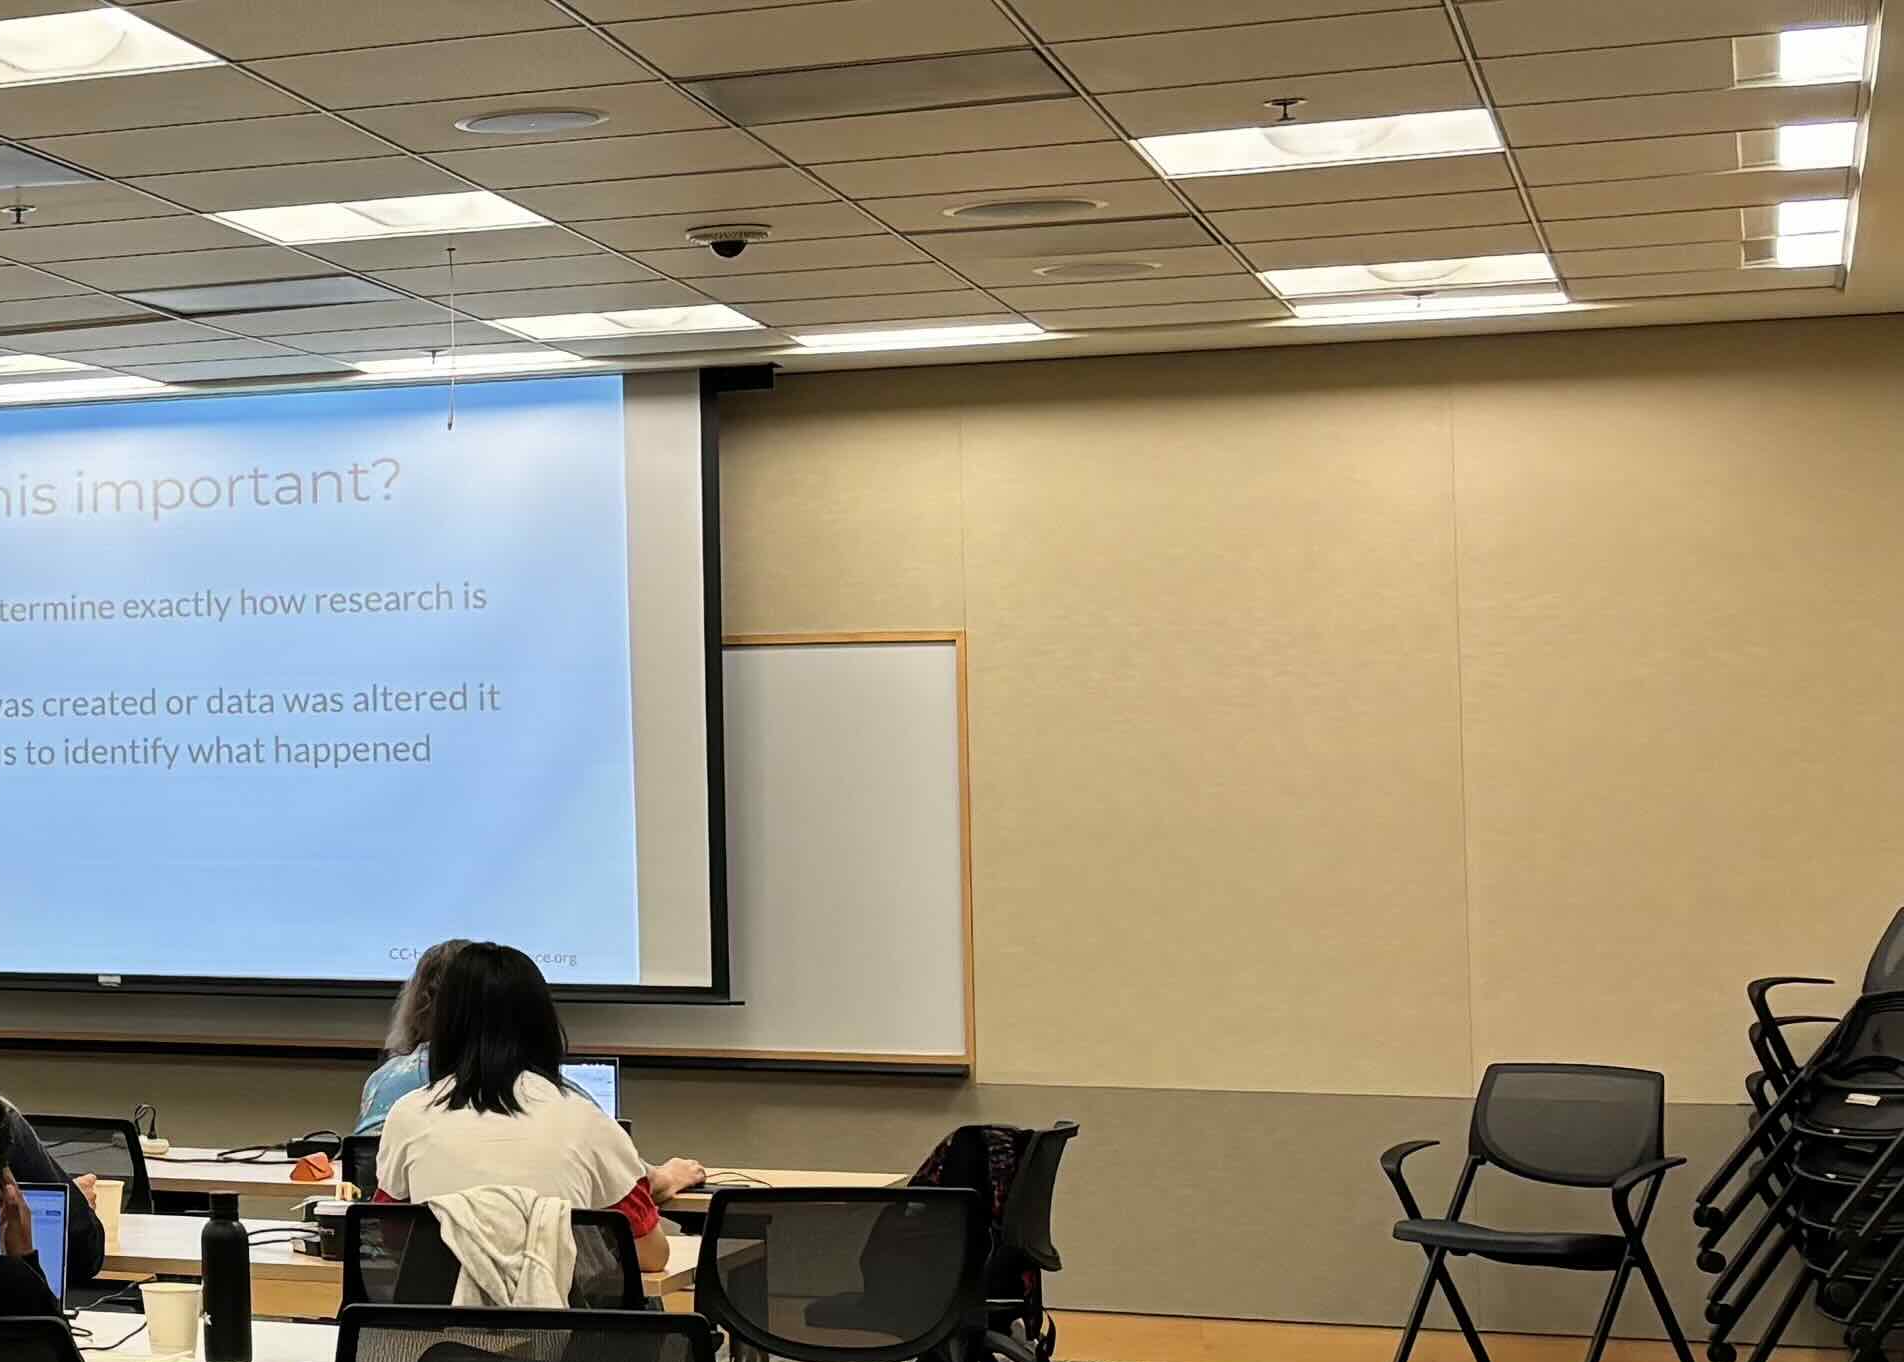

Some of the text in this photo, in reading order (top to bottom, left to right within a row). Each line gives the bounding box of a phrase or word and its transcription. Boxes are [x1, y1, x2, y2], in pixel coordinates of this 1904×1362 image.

[76, 457, 400, 520] important?
[122, 590, 232, 622] exactly
[240, 588, 306, 616] how
[314, 582, 454, 613] research
[463, 582, 488, 610] is
[41, 688, 156, 717] created
[166, 694, 198, 715] or
[206, 688, 275, 714] data
[283, 692, 345, 713] was
[353, 682, 468, 712] altered
[479, 682, 502, 711] it
[25, 741, 55, 765] to
[63, 737, 180, 770] identify
[187, 736, 266, 764] what
[274, 734, 432, 768] happened
